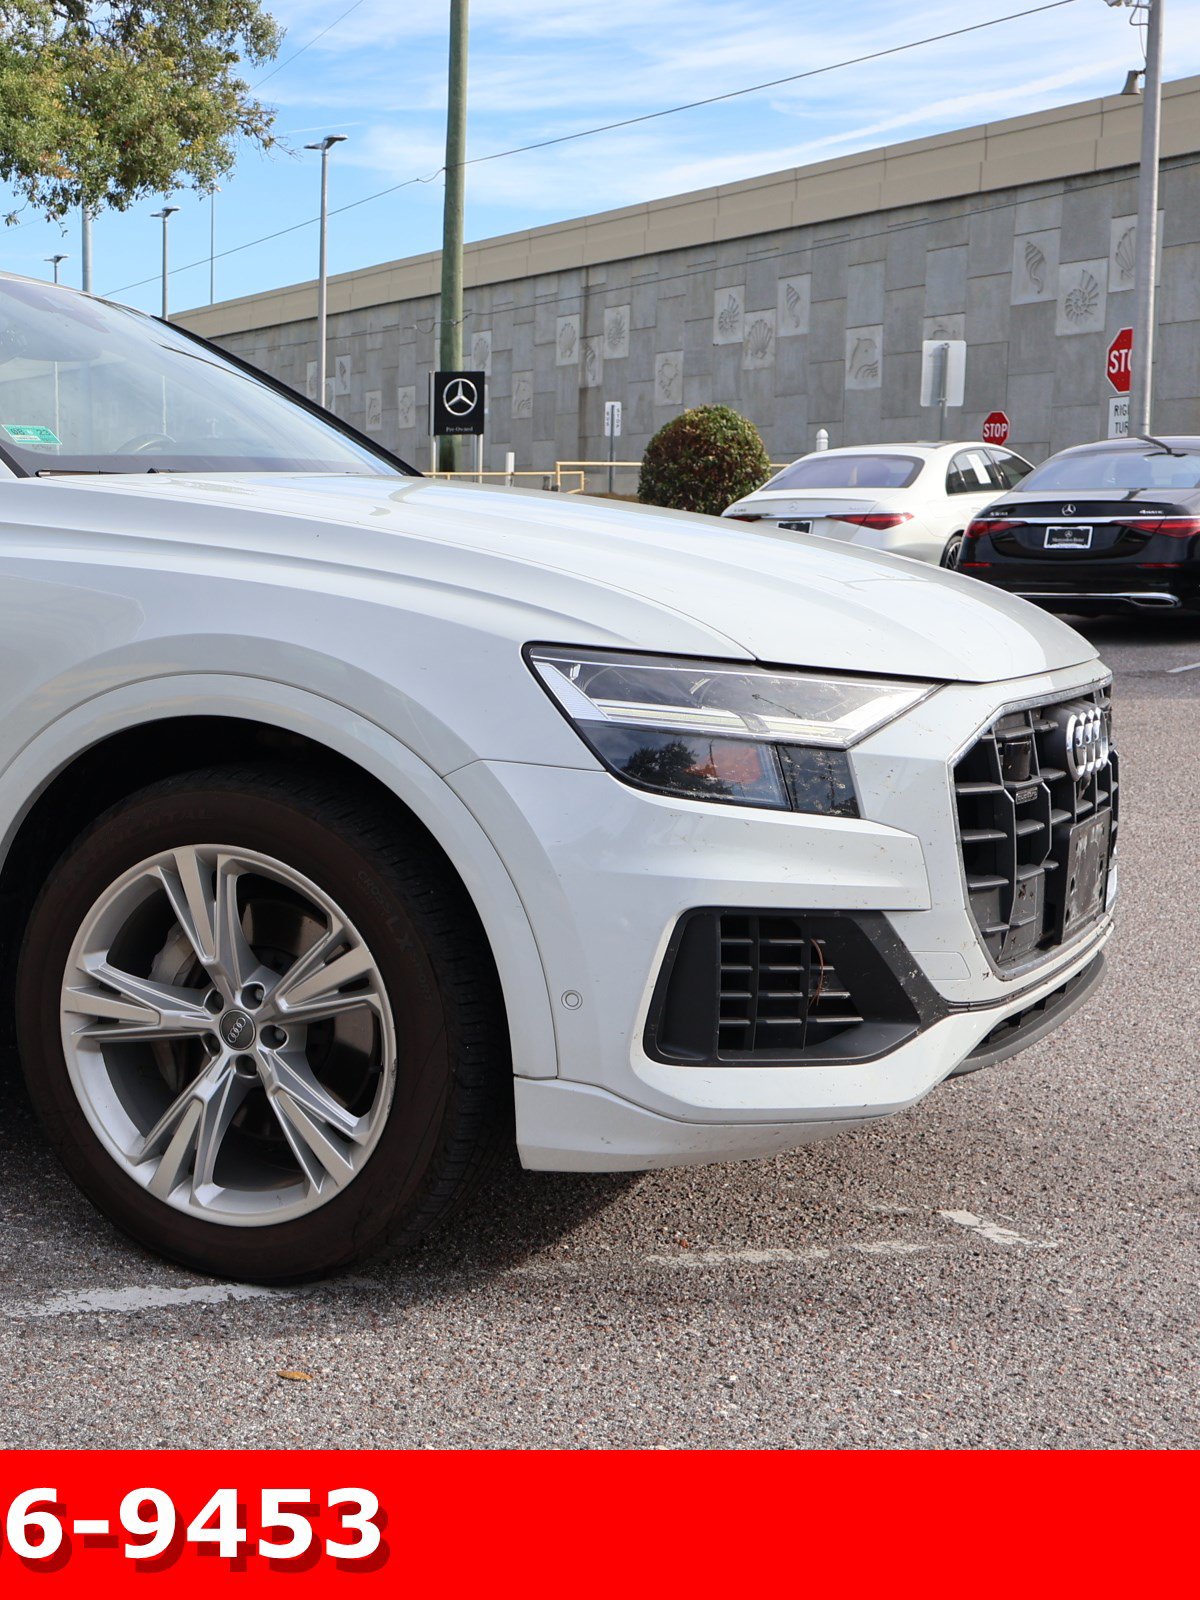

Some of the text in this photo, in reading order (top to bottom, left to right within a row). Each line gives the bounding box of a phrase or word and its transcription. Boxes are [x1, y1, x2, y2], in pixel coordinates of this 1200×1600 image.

[1109, 349, 1132, 374] ST
[1114, 404, 1129, 417] RIG
[983, 423, 1008, 438] STOP
[1115, 421, 1129, 434] TUR
